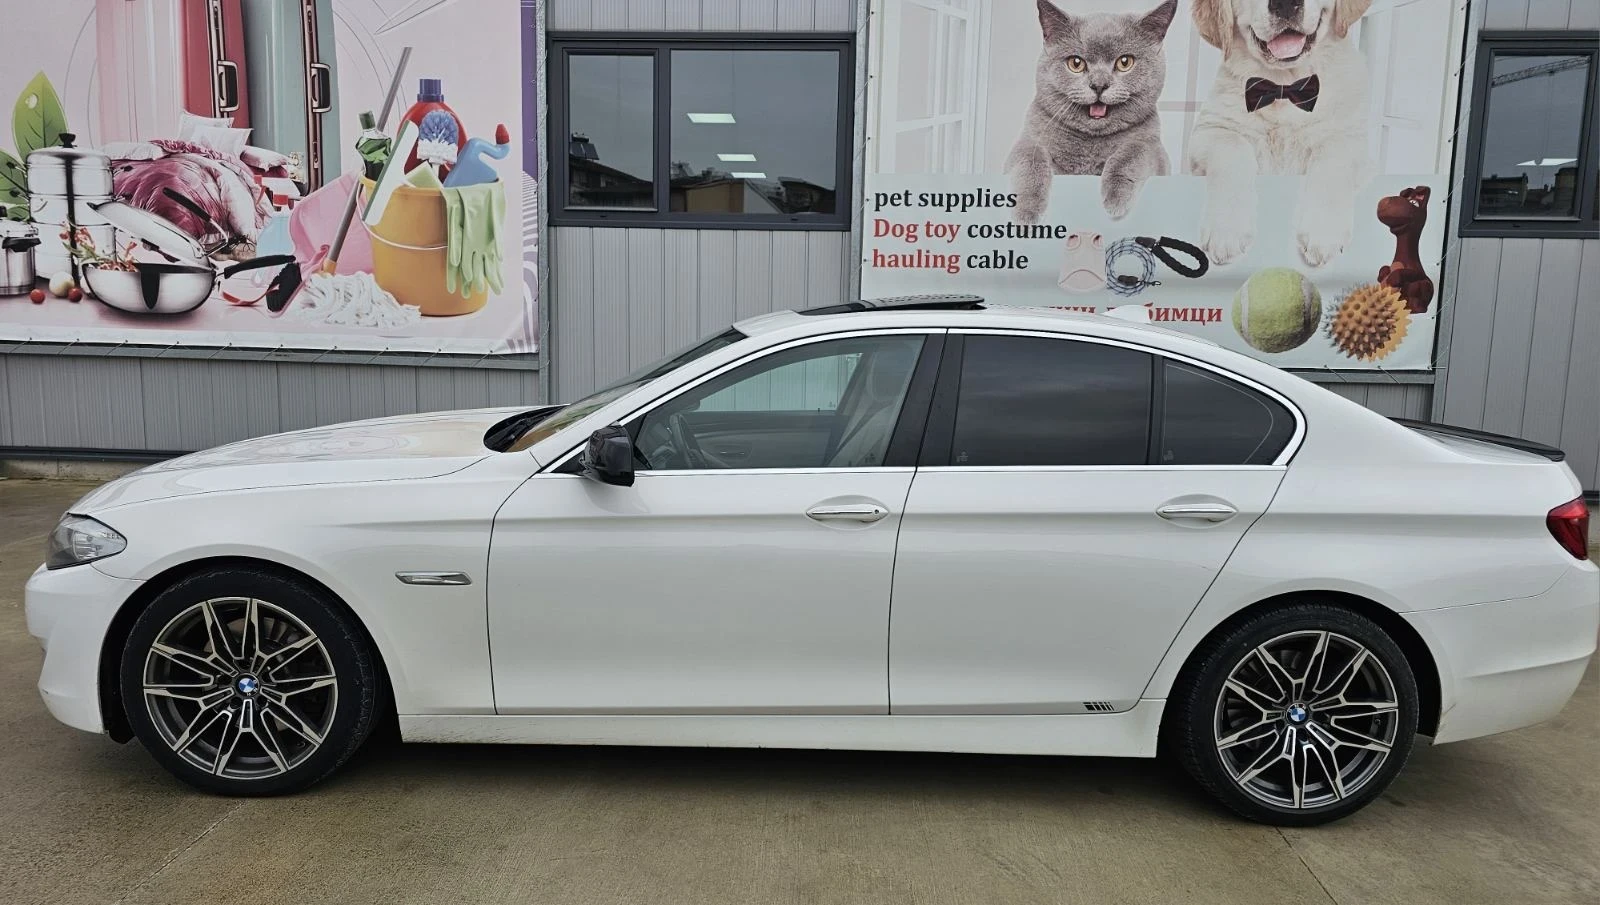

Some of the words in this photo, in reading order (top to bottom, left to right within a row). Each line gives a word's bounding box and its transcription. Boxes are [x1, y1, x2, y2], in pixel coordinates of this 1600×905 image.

[874, 189, 913, 212] pet
[917, 188, 1018, 213] supplies
[873, 218, 919, 243] Dog
[925, 221, 961, 243] toy
[967, 221, 1067, 239] costume
[872, 249, 961, 274] hauling
[966, 249, 1029, 270] cable
